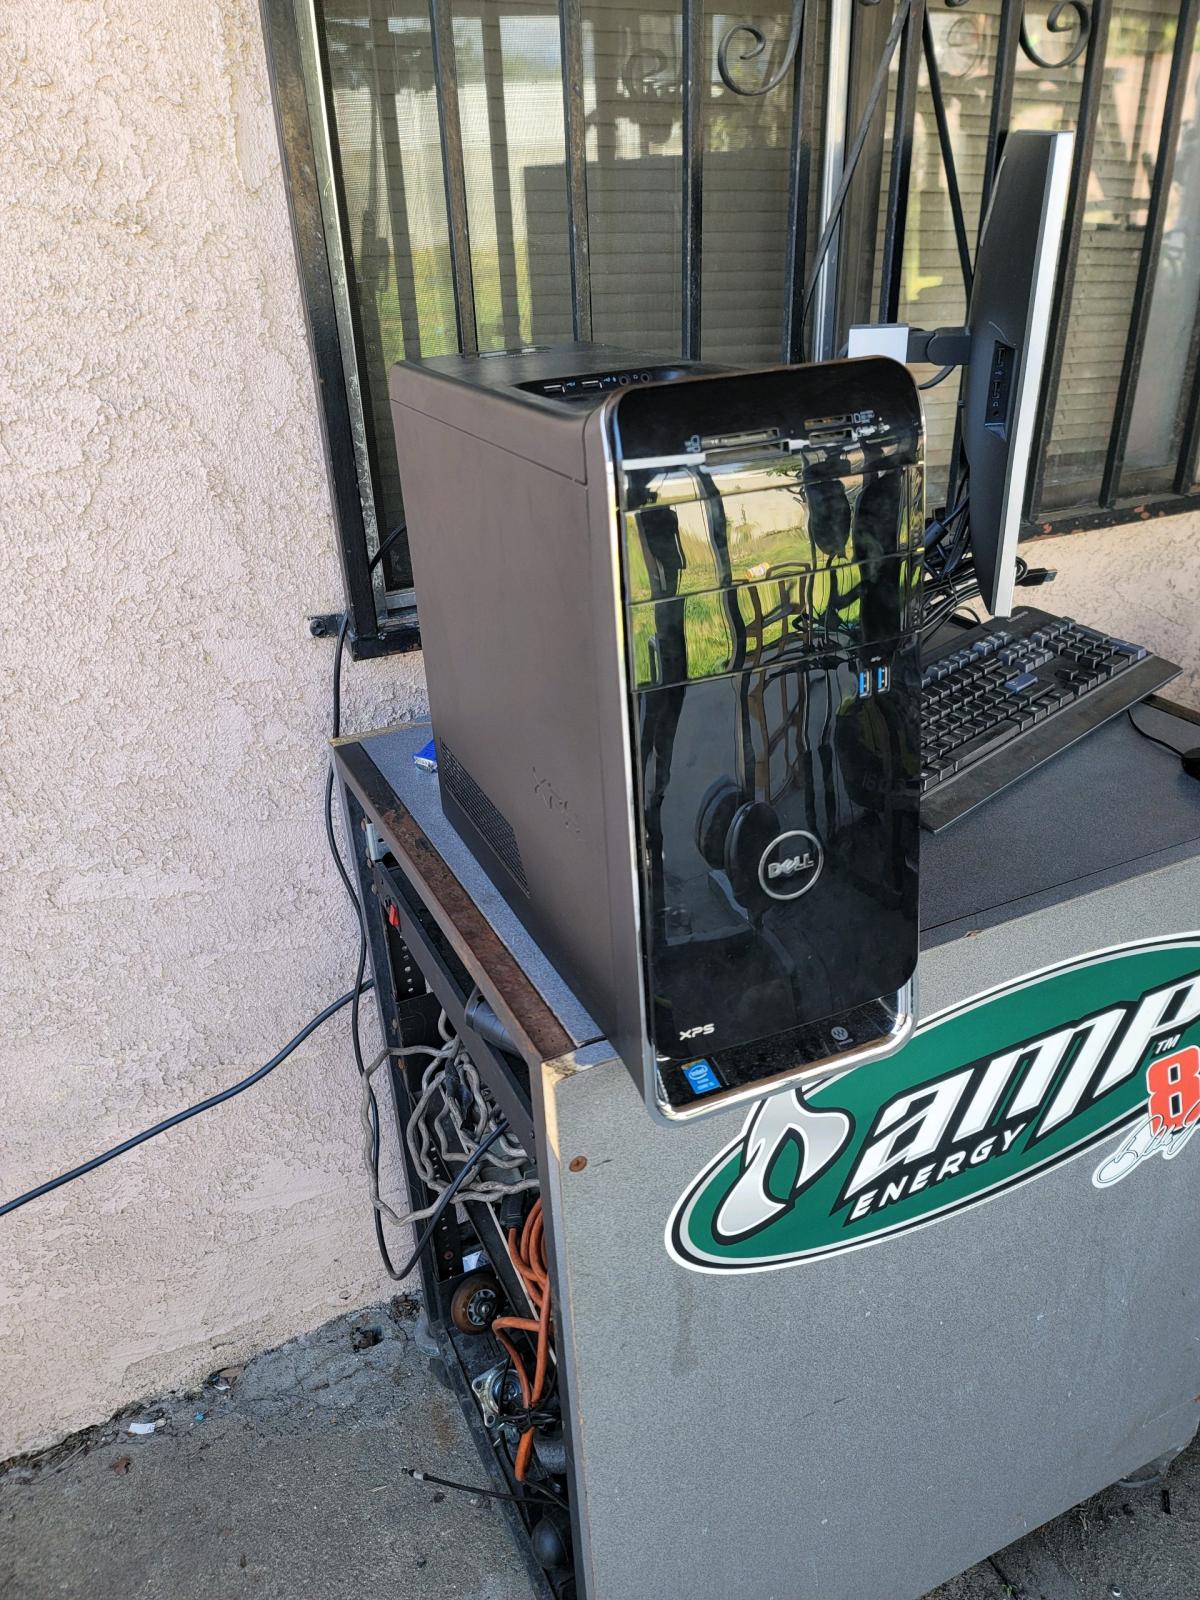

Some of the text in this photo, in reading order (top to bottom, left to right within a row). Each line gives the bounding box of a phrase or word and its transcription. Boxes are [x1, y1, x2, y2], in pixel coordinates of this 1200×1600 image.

[767, 852, 815, 879] DELL
[679, 1023, 716, 1041] XPS
[1155, 1034, 1181, 1054] TM
[849, 1123, 1027, 1221] ENERGY
